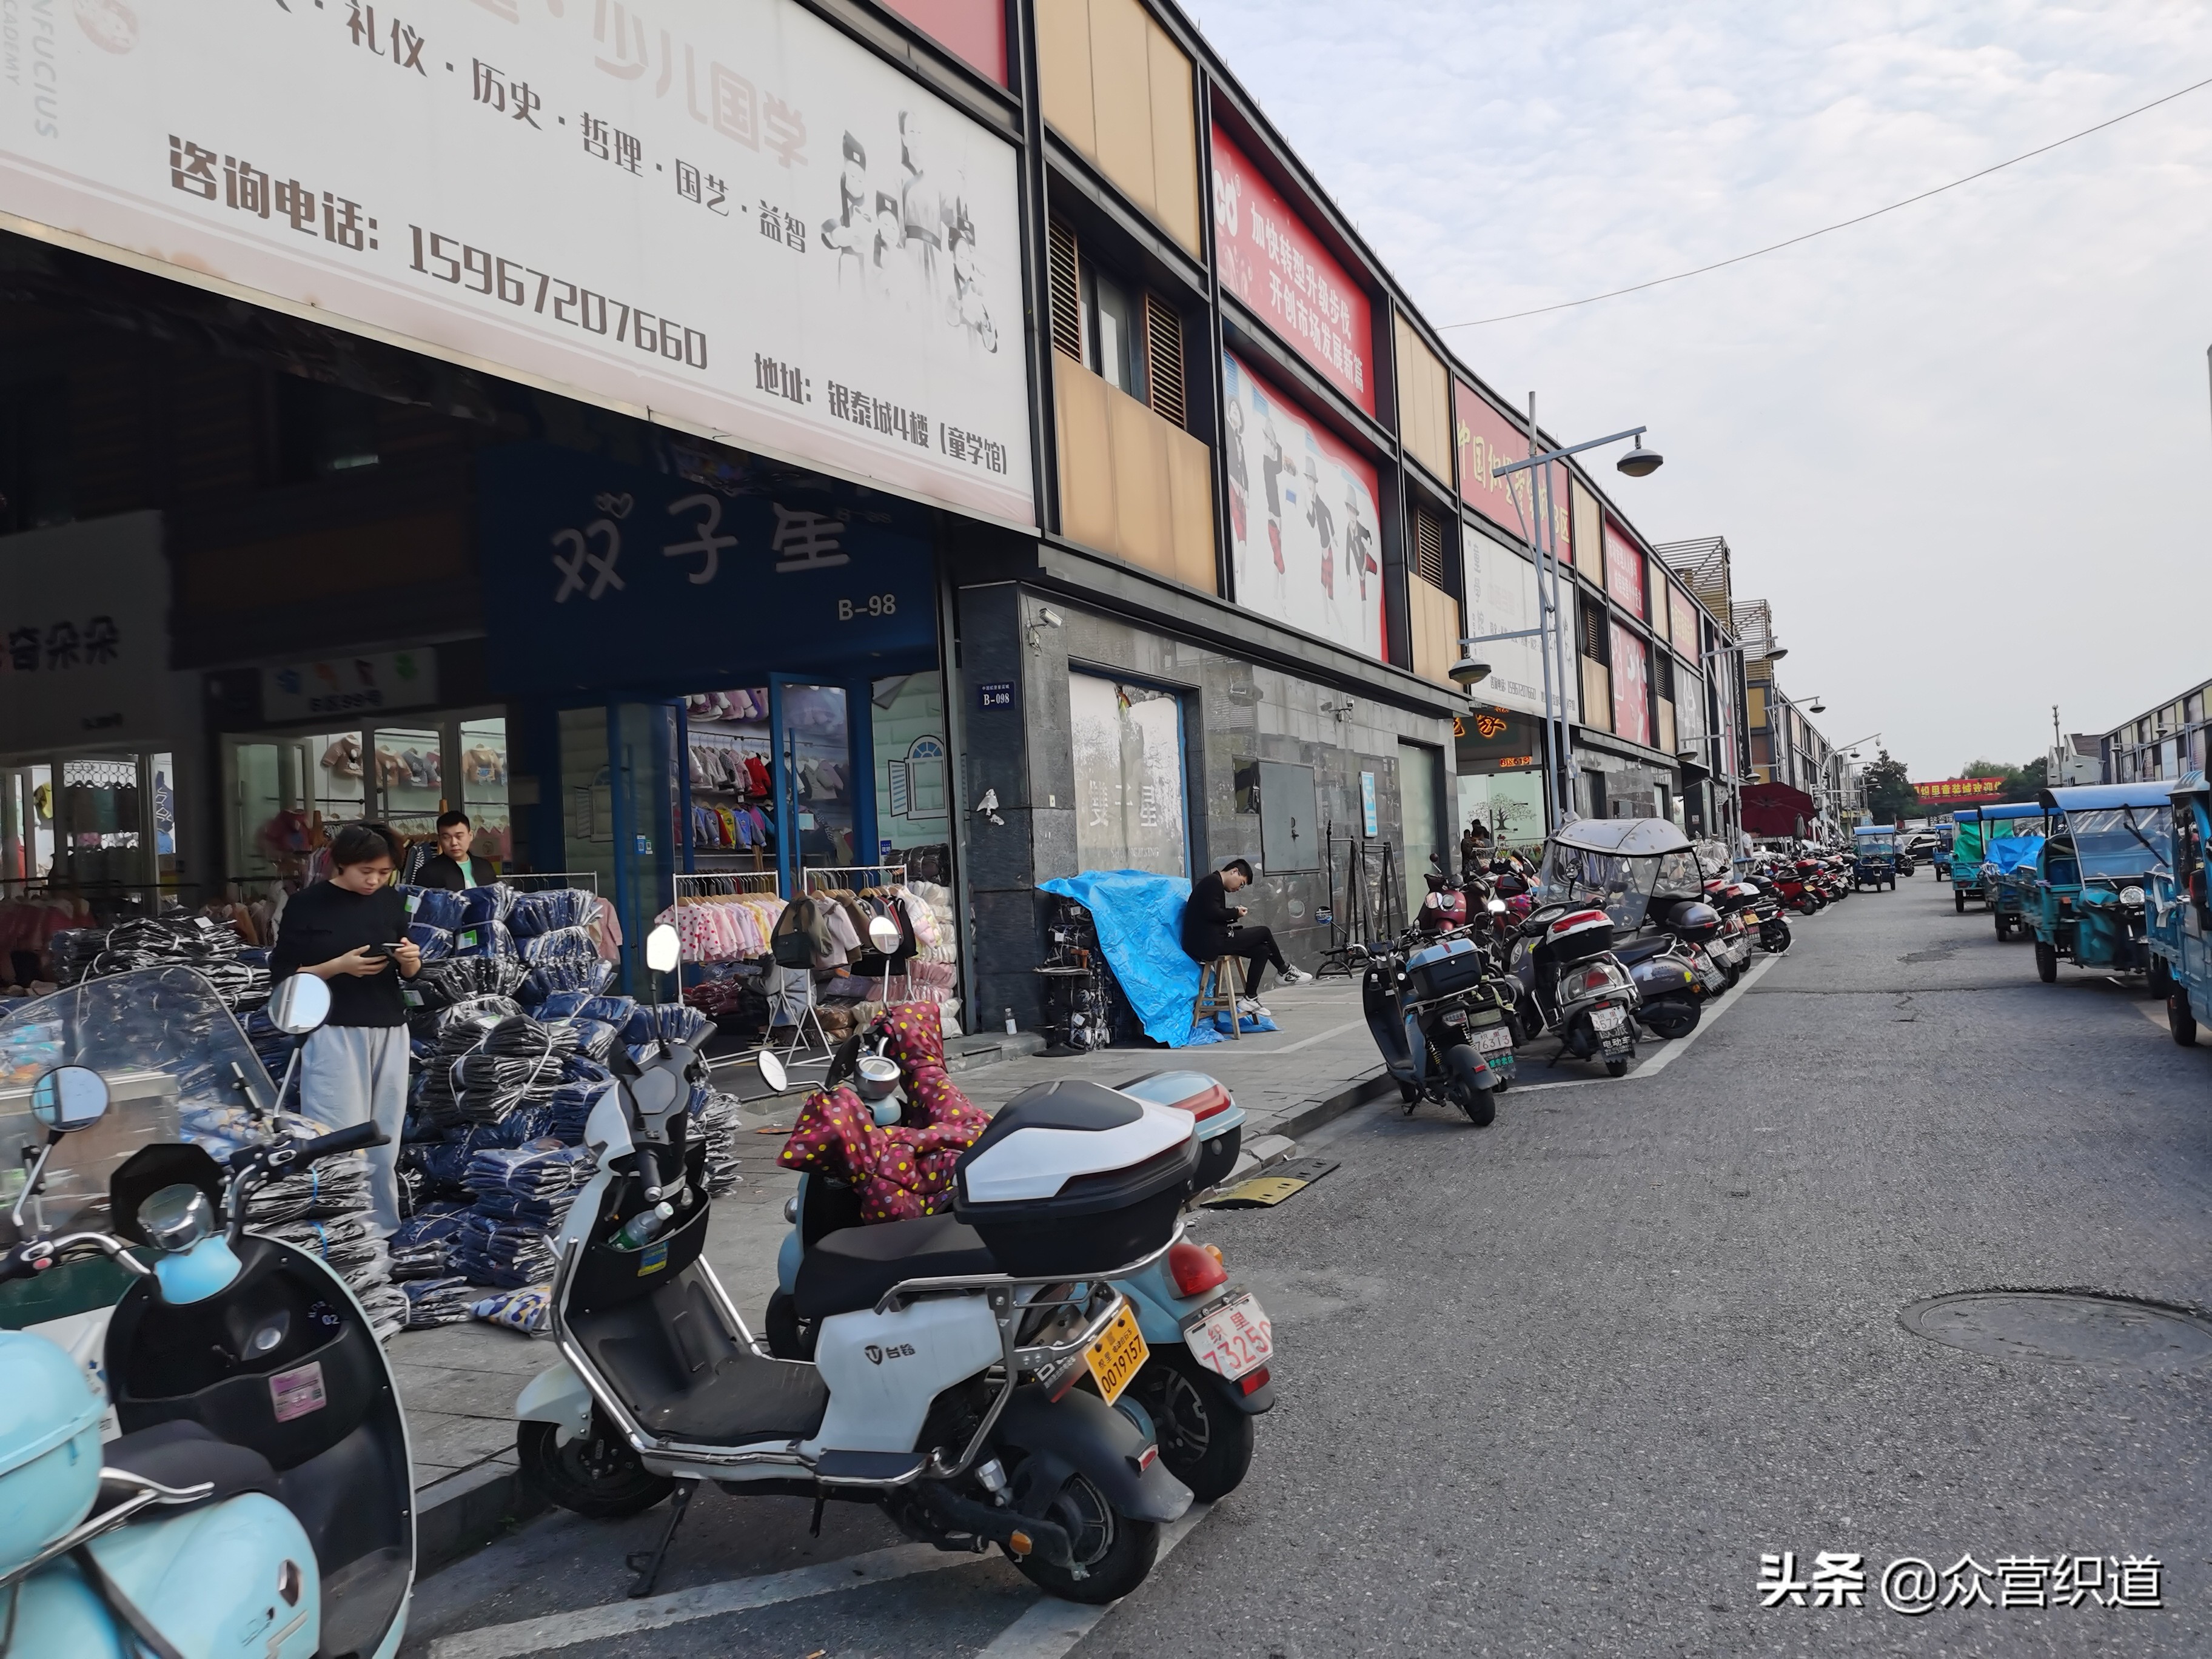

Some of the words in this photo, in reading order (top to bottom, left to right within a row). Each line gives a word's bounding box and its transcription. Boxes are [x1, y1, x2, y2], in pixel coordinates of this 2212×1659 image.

[1250, 201, 1352, 341] 加快转型升级步伐
[409, 224, 708, 370] 15967207660
[1269, 269, 1364, 394] 开创市场发展新篇
[838, 594, 896, 621] B-98
[984, 692, 1010, 705] B-098
[1474, 1035, 1510, 1051] 76313
[1602, 1036, 1631, 1048] 电动车
[1101, 1333, 1142, 1394] 0019157
